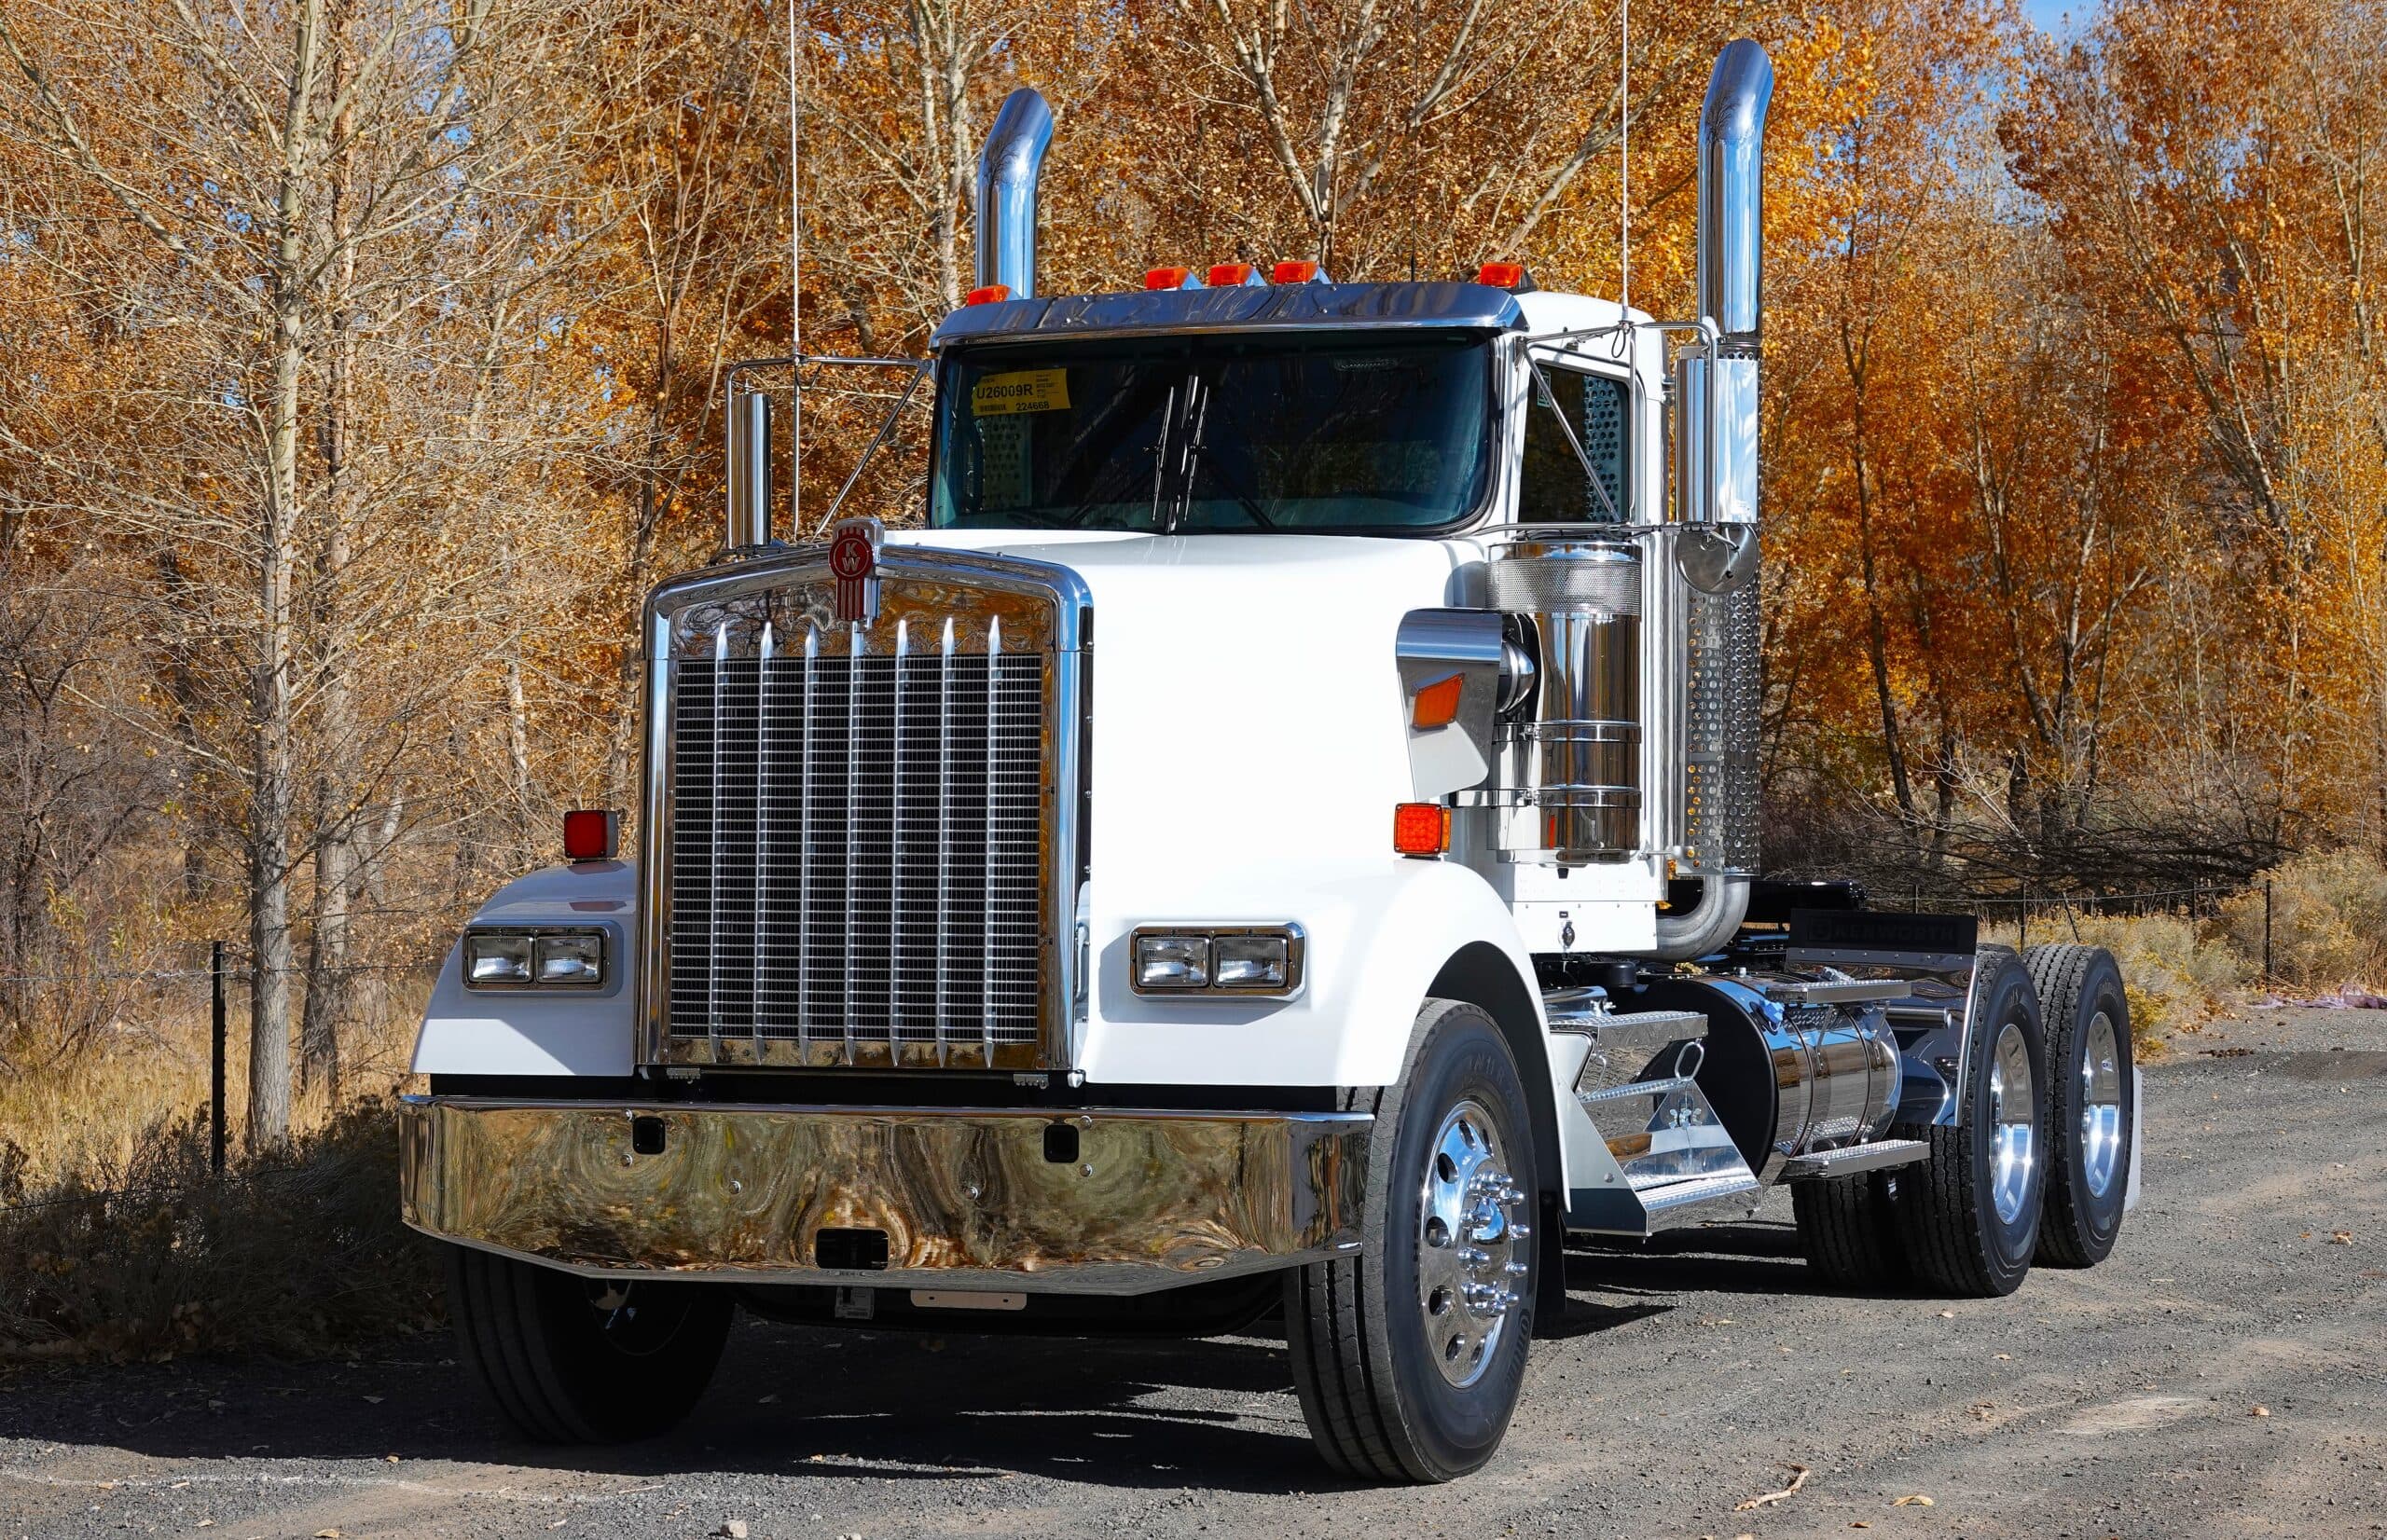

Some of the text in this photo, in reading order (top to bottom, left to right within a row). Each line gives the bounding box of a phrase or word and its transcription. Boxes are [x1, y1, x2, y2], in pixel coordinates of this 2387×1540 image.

[976, 383, 1033, 399] U26009R
[1015, 401, 1050, 412] 224668
[846, 543, 858, 557] K
[842, 557, 861, 572] W
